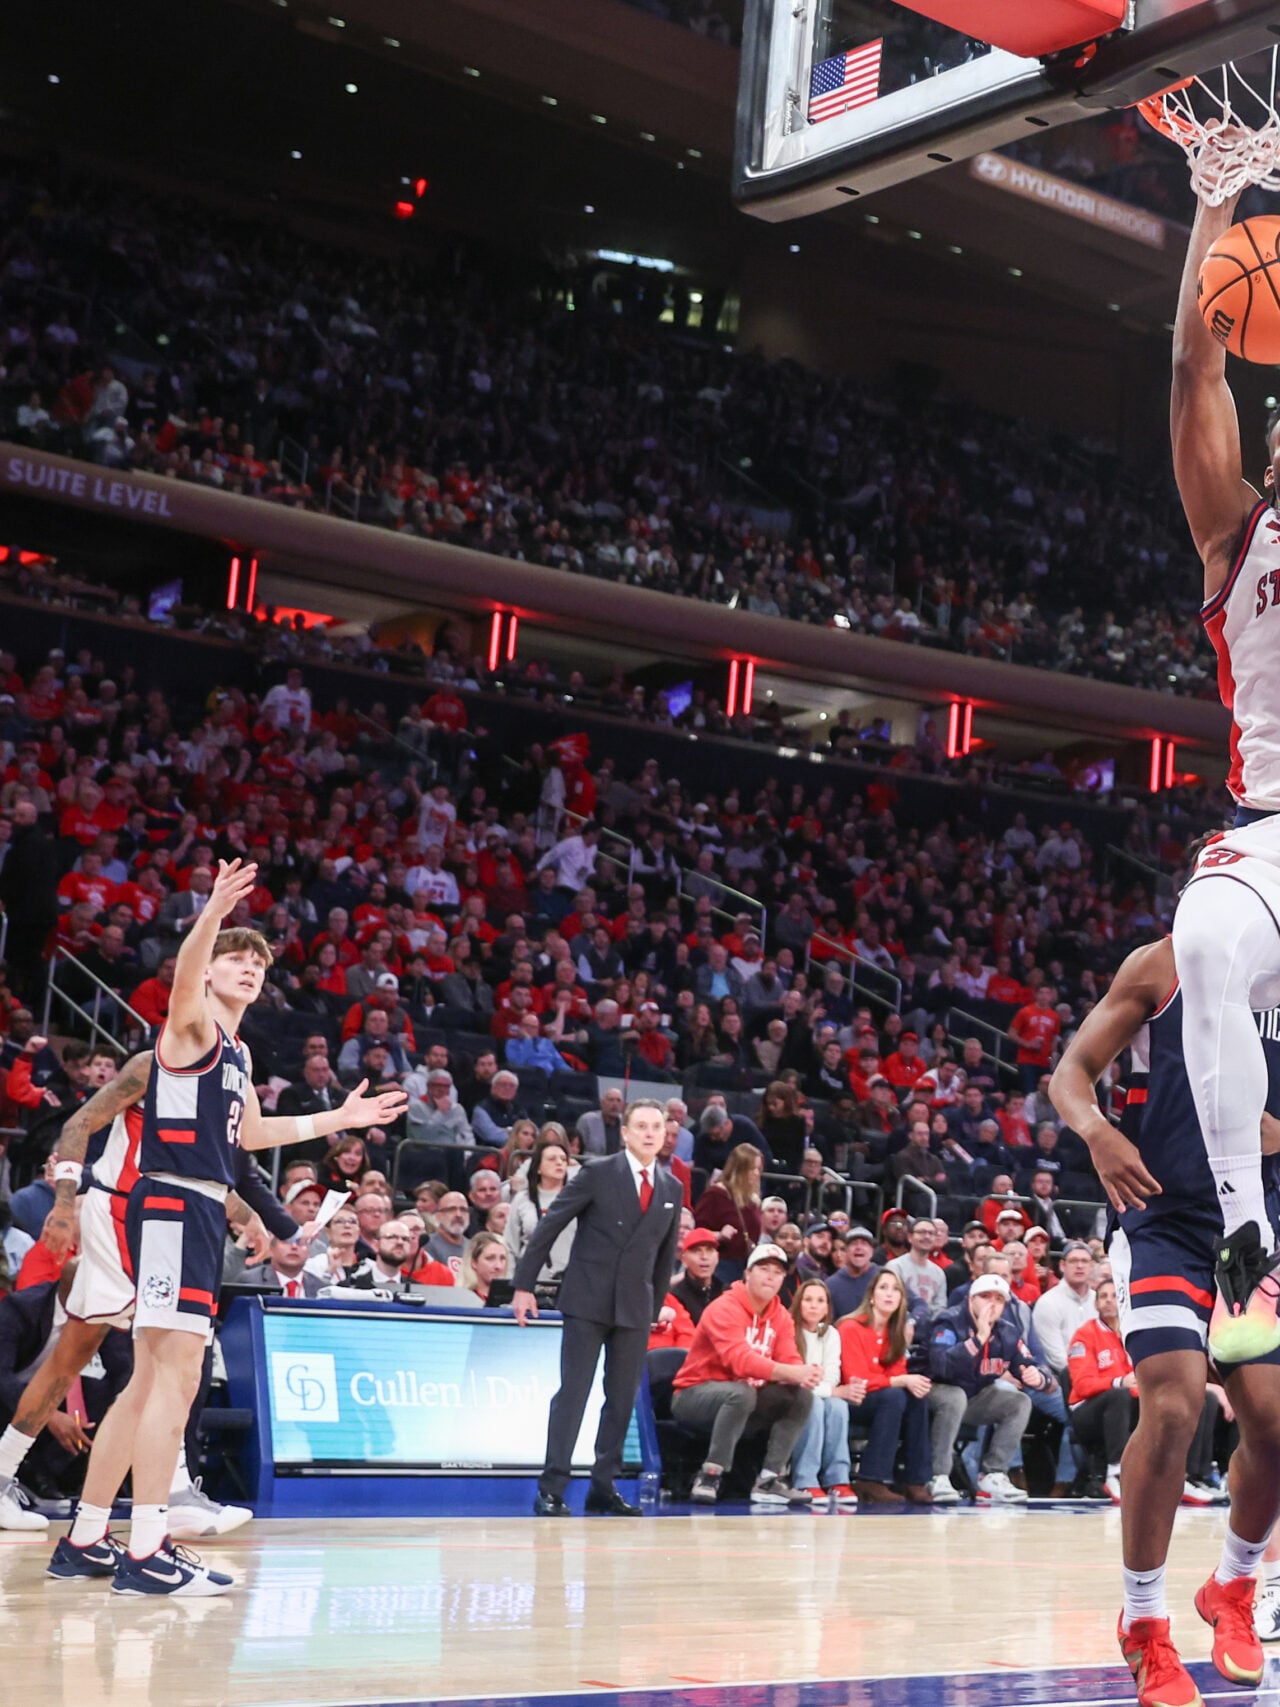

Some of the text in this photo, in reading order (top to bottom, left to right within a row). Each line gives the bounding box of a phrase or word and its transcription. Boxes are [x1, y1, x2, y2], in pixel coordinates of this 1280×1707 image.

[1009, 168, 1095, 216] HYUNDAI
[8, 458, 172, 517] SUITE LEVEL
[350, 1369, 462, 1408] Cullen
